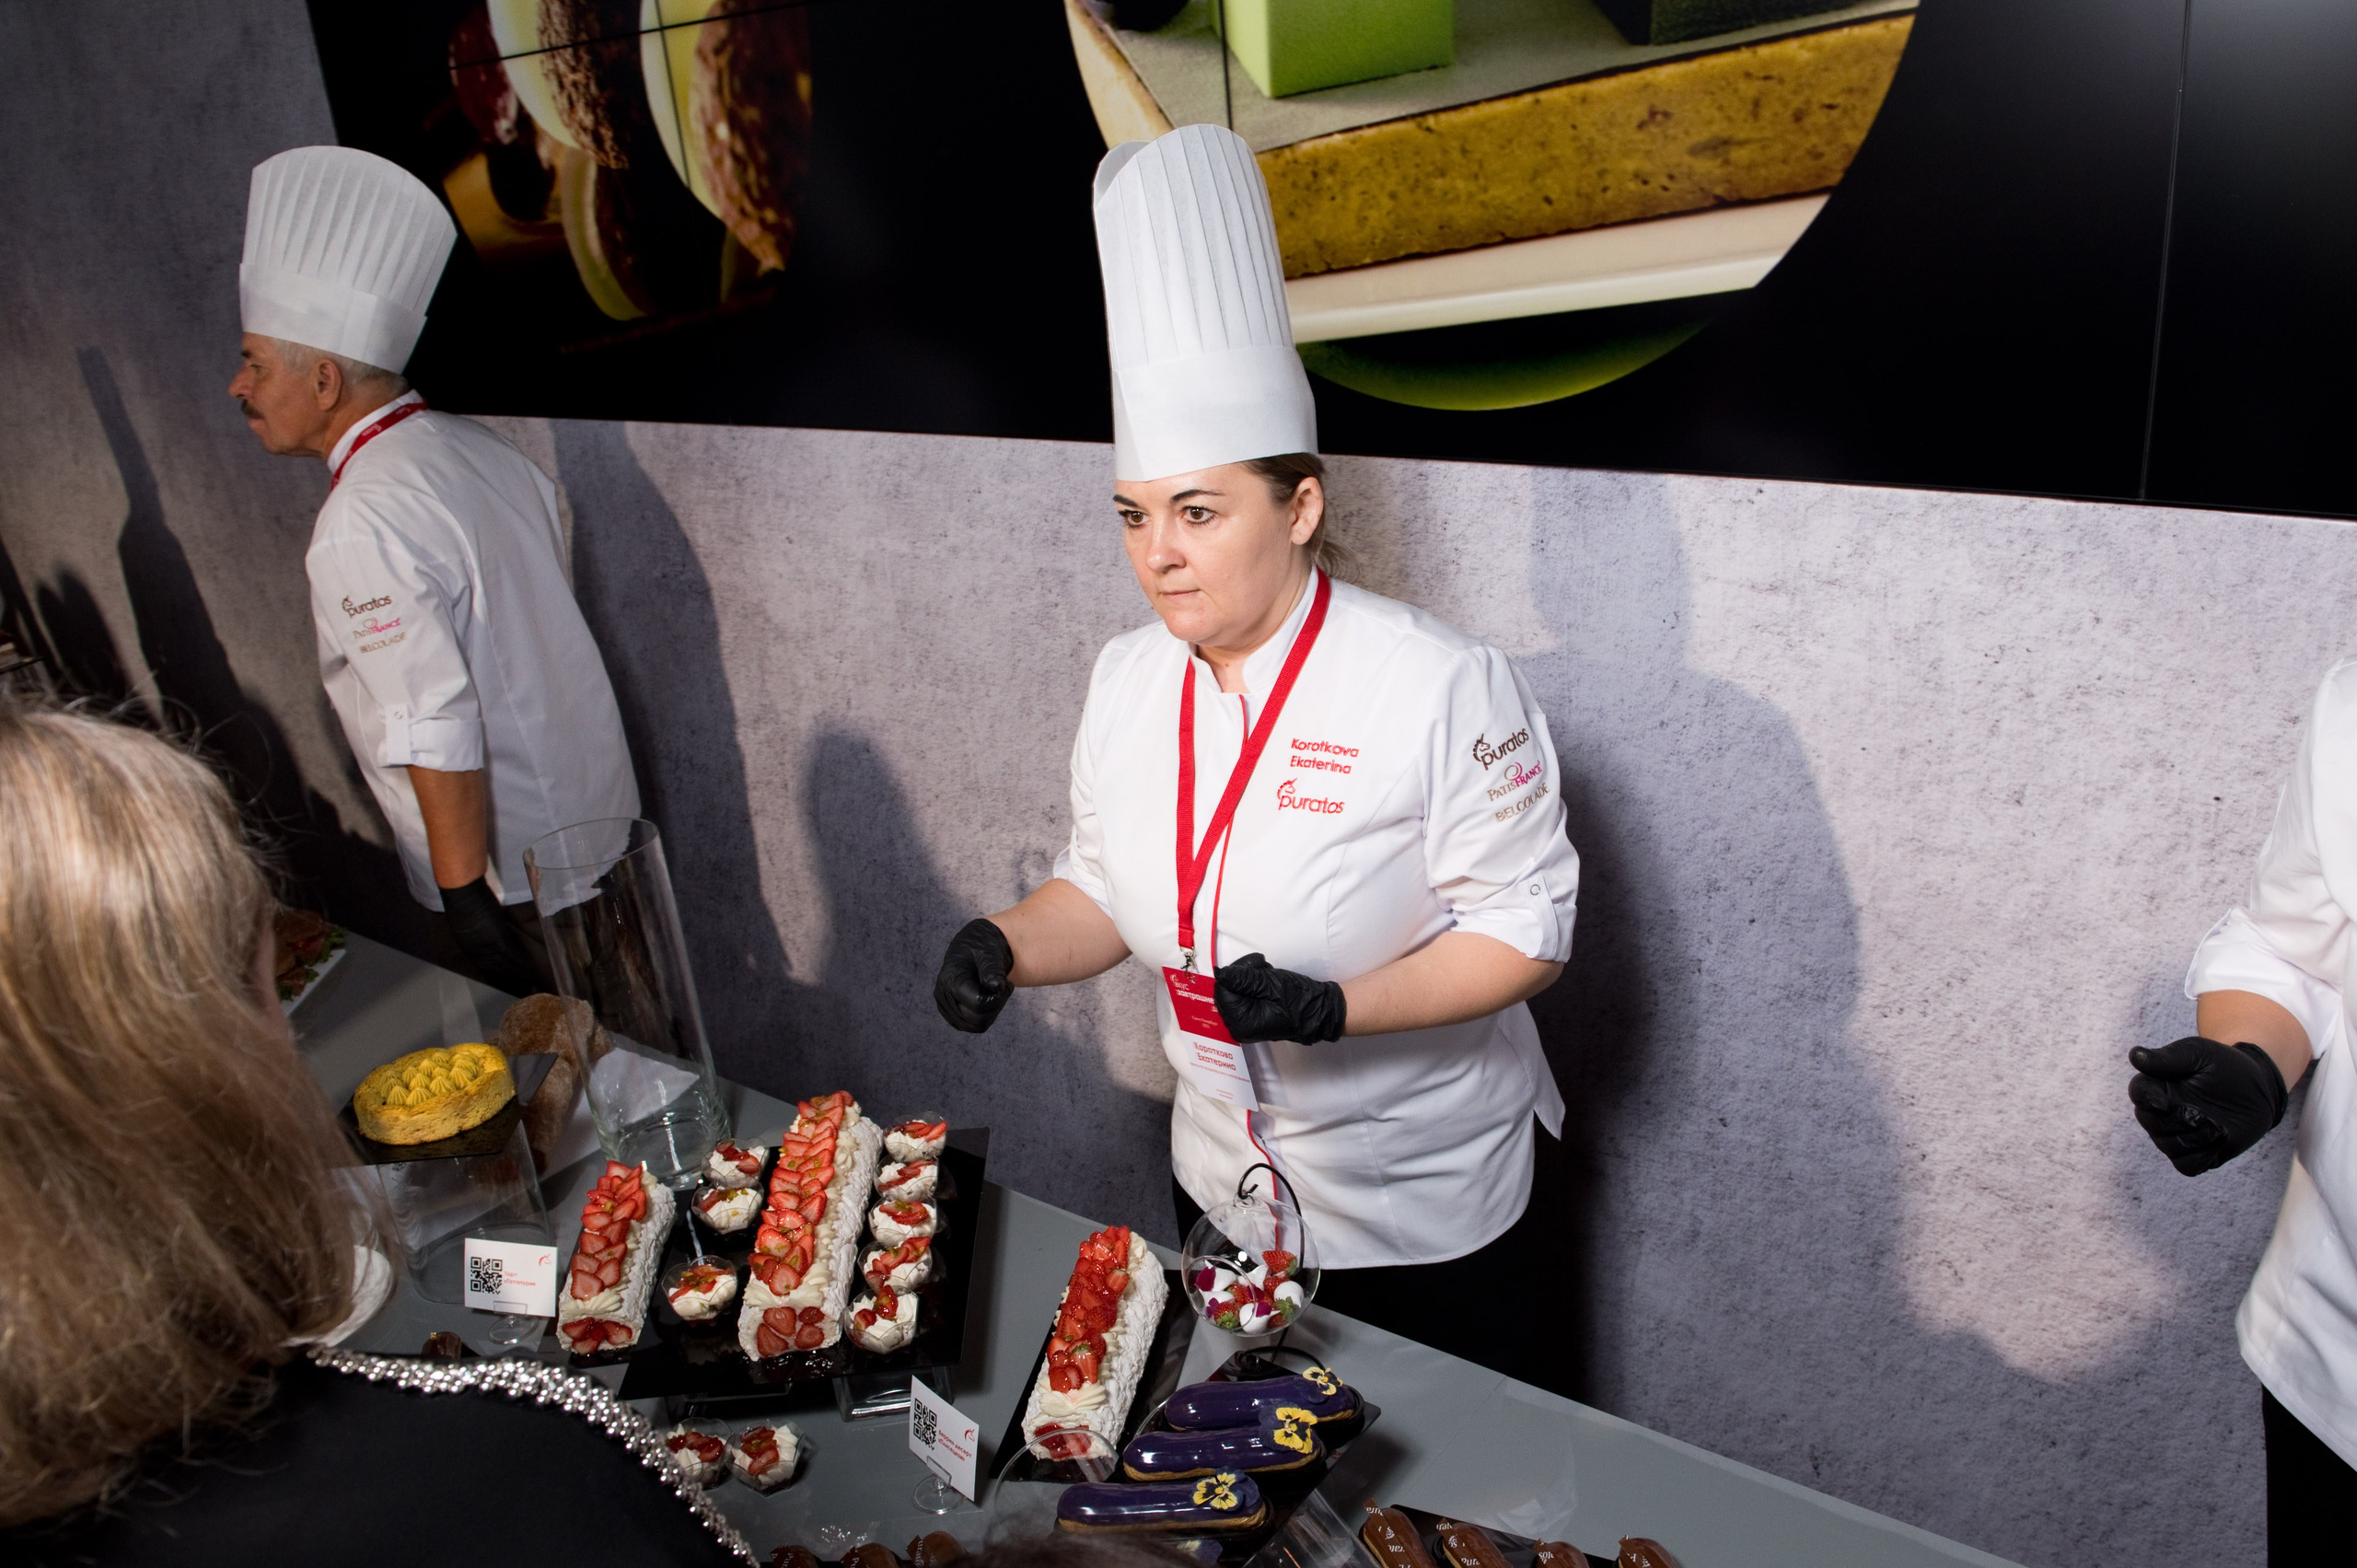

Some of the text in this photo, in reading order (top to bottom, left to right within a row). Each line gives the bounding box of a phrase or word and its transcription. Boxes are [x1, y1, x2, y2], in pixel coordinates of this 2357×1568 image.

[348, 596, 392, 618] puratos
[1291, 738, 1359, 758] Korotkova
[1480, 728, 1529, 771] puratos
[1290, 755, 1352, 774] Ekaterina
[1278, 795, 1345, 814] puratos
[1495, 783, 1550, 822] BELCOLADE
